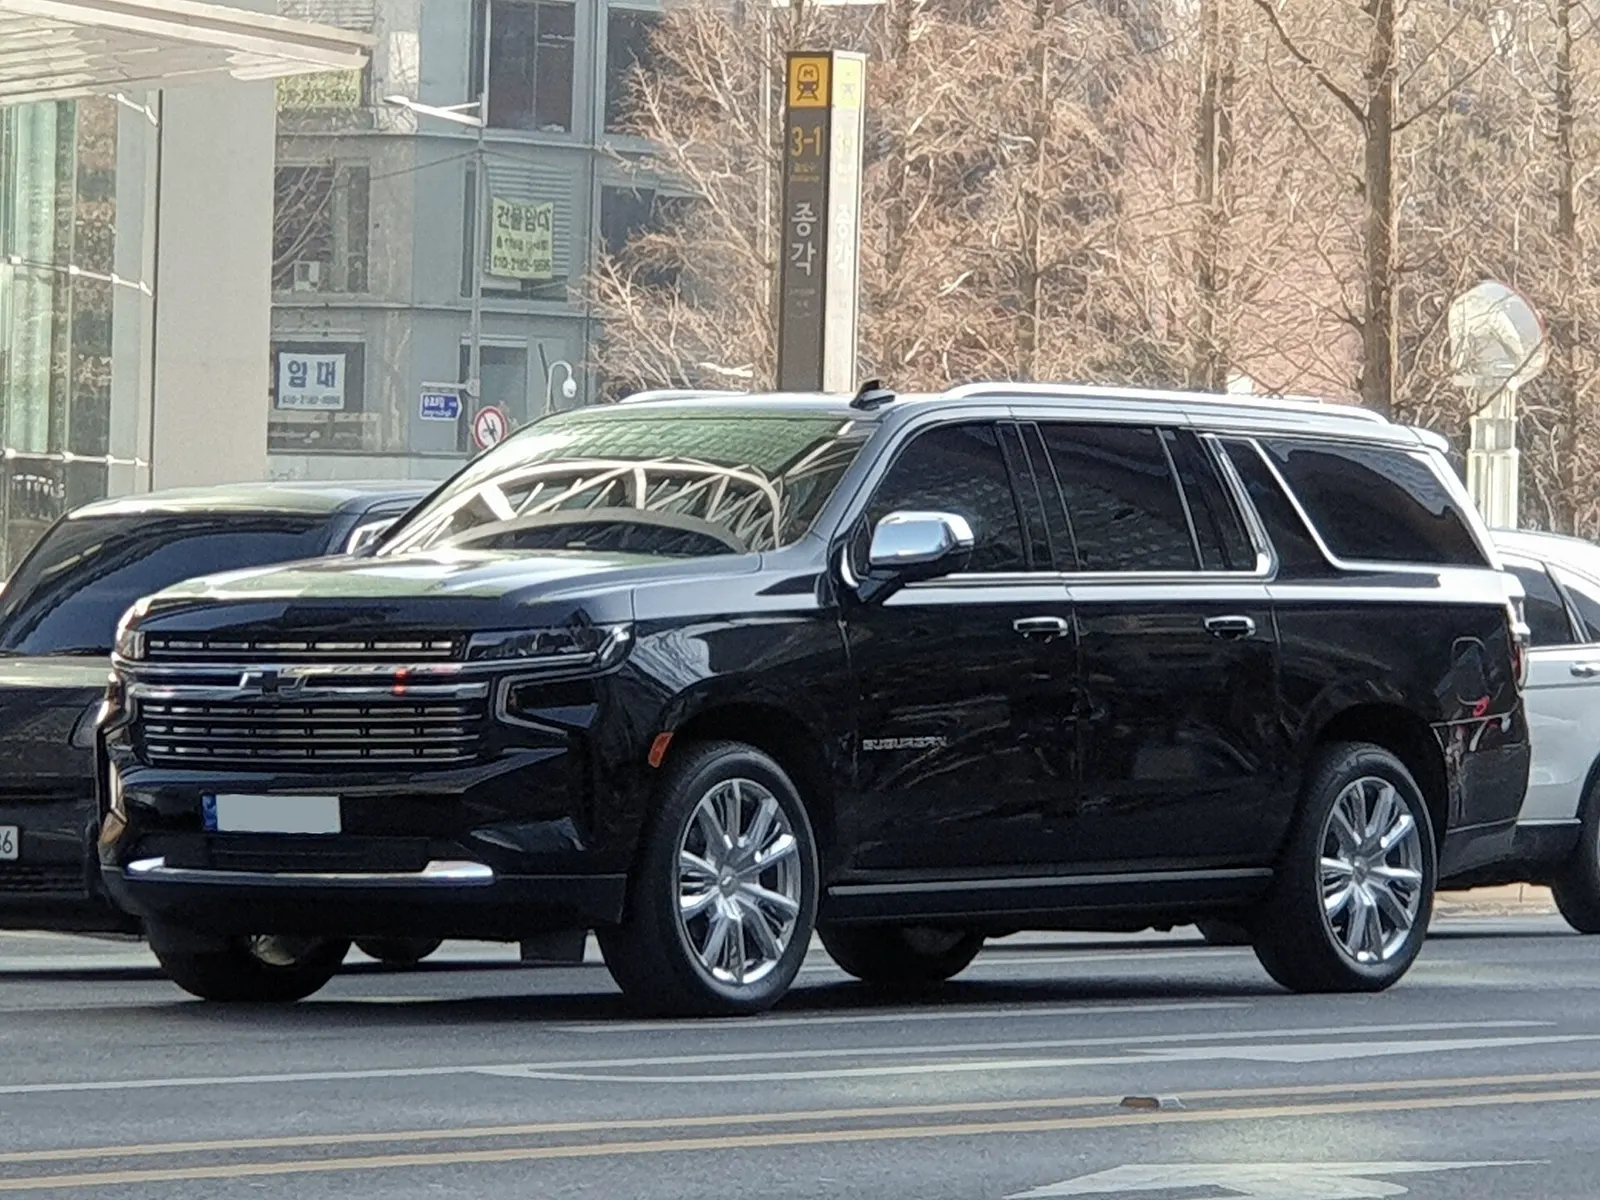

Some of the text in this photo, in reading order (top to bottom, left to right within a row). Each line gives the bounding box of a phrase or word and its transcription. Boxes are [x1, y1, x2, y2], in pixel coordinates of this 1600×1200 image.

[791, 126, 821, 157] 3-1
[790, 202, 817, 276] 종각
[0, 830, 13, 854] 6
